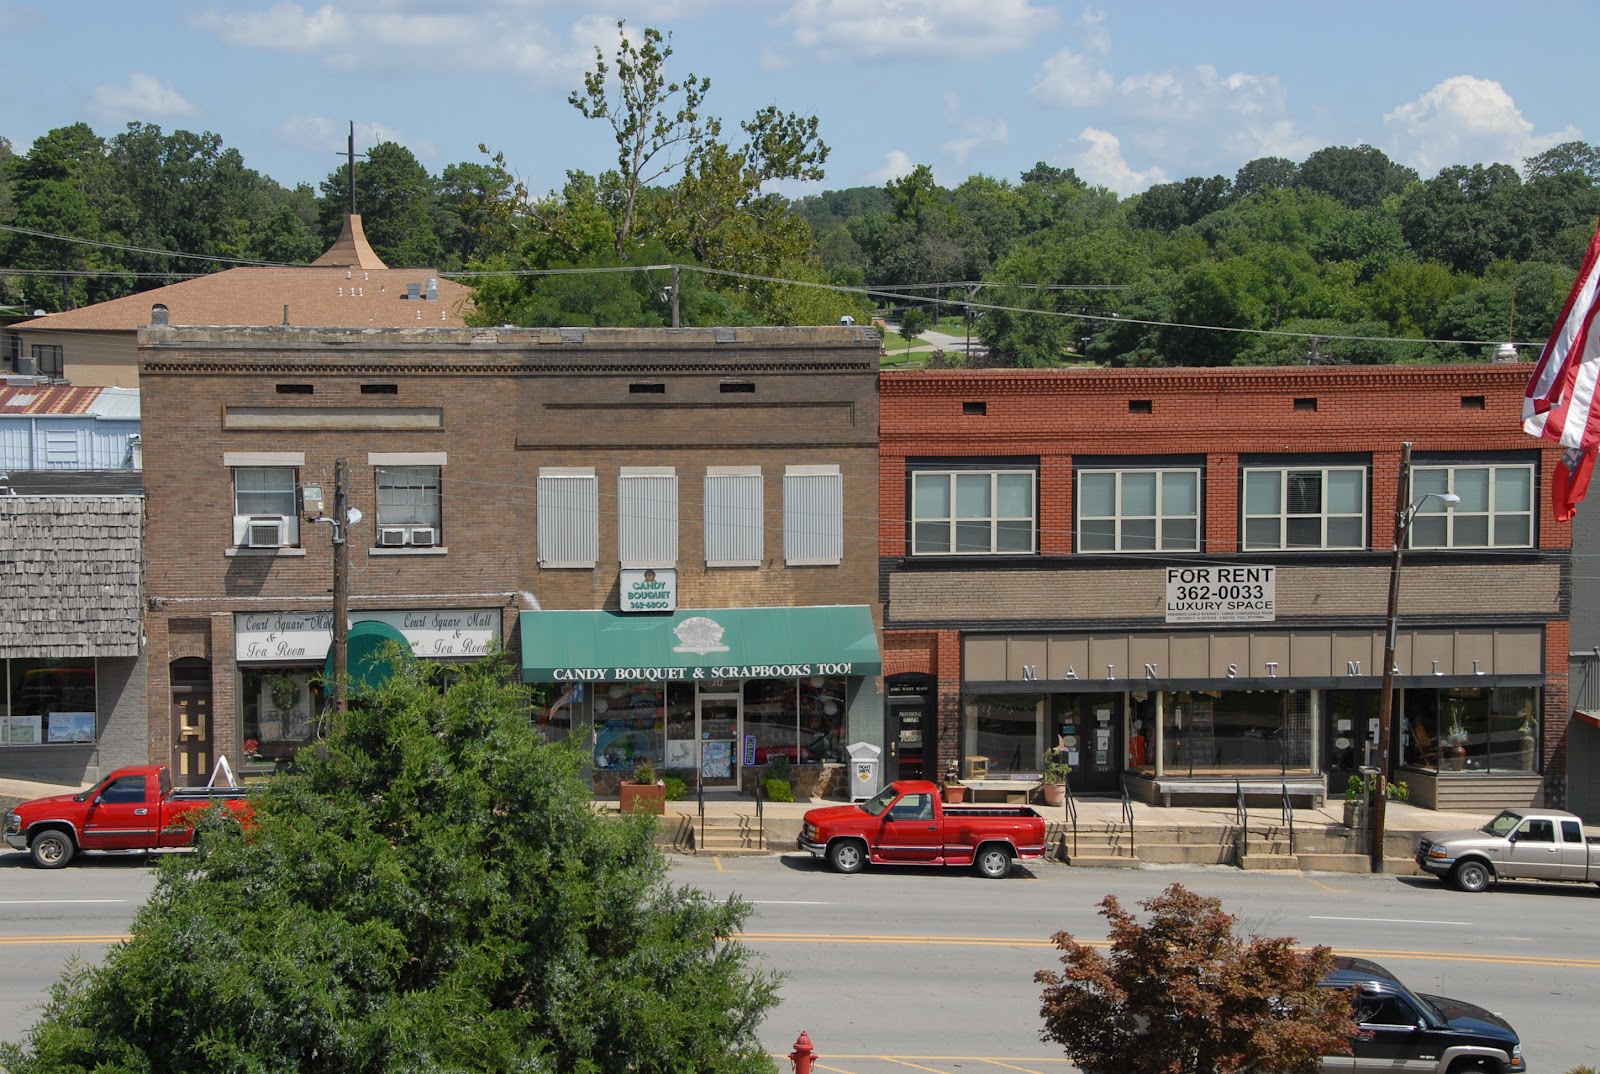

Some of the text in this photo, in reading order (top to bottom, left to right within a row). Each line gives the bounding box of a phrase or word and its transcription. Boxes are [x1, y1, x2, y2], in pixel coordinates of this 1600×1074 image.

[1168, 568, 1274, 583] FOR RENT
[632, 581, 666, 590] CANDY
[1176, 585, 1264, 600] 362-0033
[627, 591, 671, 600] BOUQUET
[630, 601, 669, 609] 362-6800
[1167, 600, 1273, 611] LUXURY SPACE
[245, 615, 269, 630] Court
[274, 614, 305, 635] Square
[404, 611, 492, 631] Court Square Mall
[266, 632, 276, 642] &
[452, 629, 462, 639] &
[246, 641, 305, 657] Tea Room
[432, 639, 453, 654] Tea
[553, 662, 852, 682] CANDY BOUQUET & SCRAPBOOKS TOO!
[1022, 660, 1486, 681] MAIN ST MALL
[746, 737, 754, 763] OPEN
